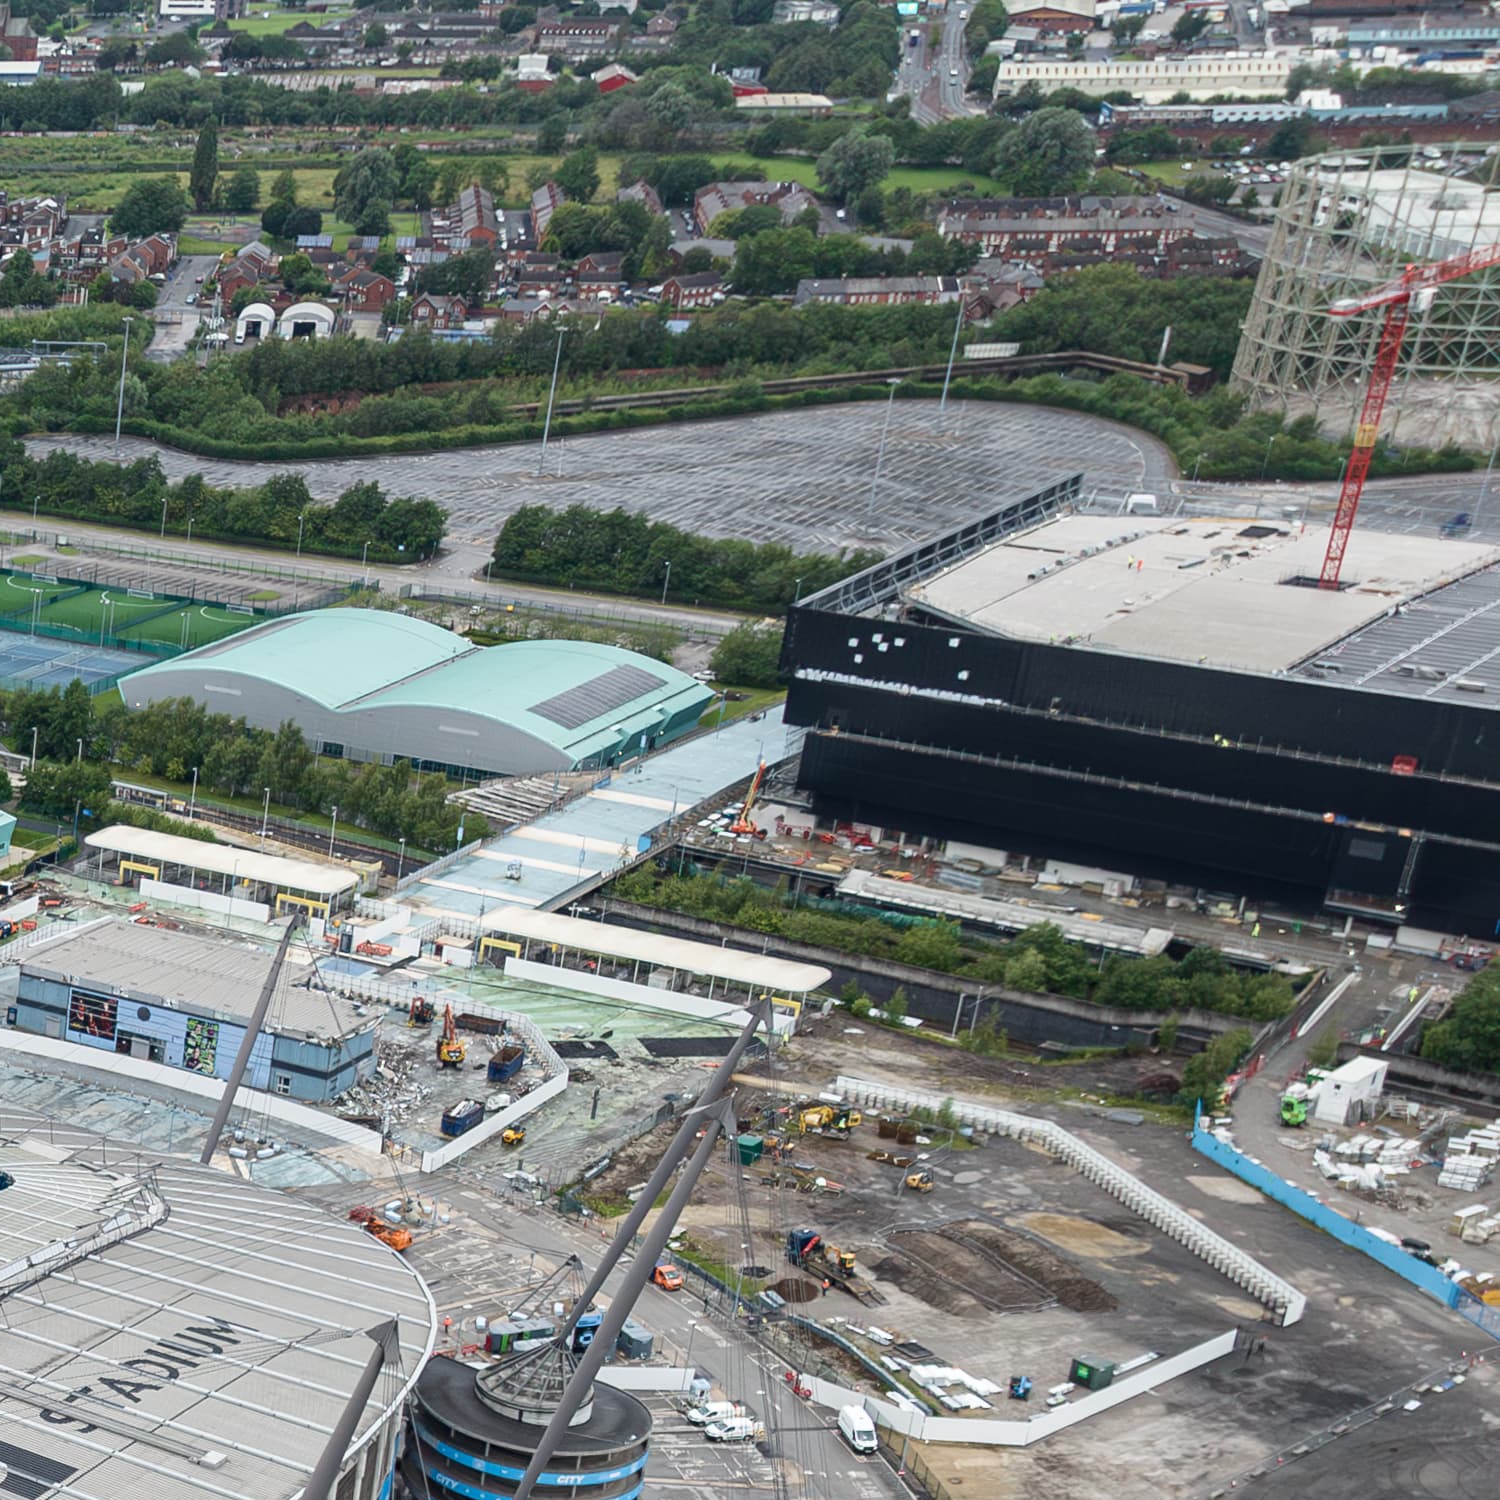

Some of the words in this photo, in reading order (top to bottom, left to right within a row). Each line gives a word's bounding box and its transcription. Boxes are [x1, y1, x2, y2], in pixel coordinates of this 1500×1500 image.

[40, 1317, 259, 1434] STADIUM
[437, 1473, 458, 1488] CITY
[557, 1474, 585, 1485] CITY
